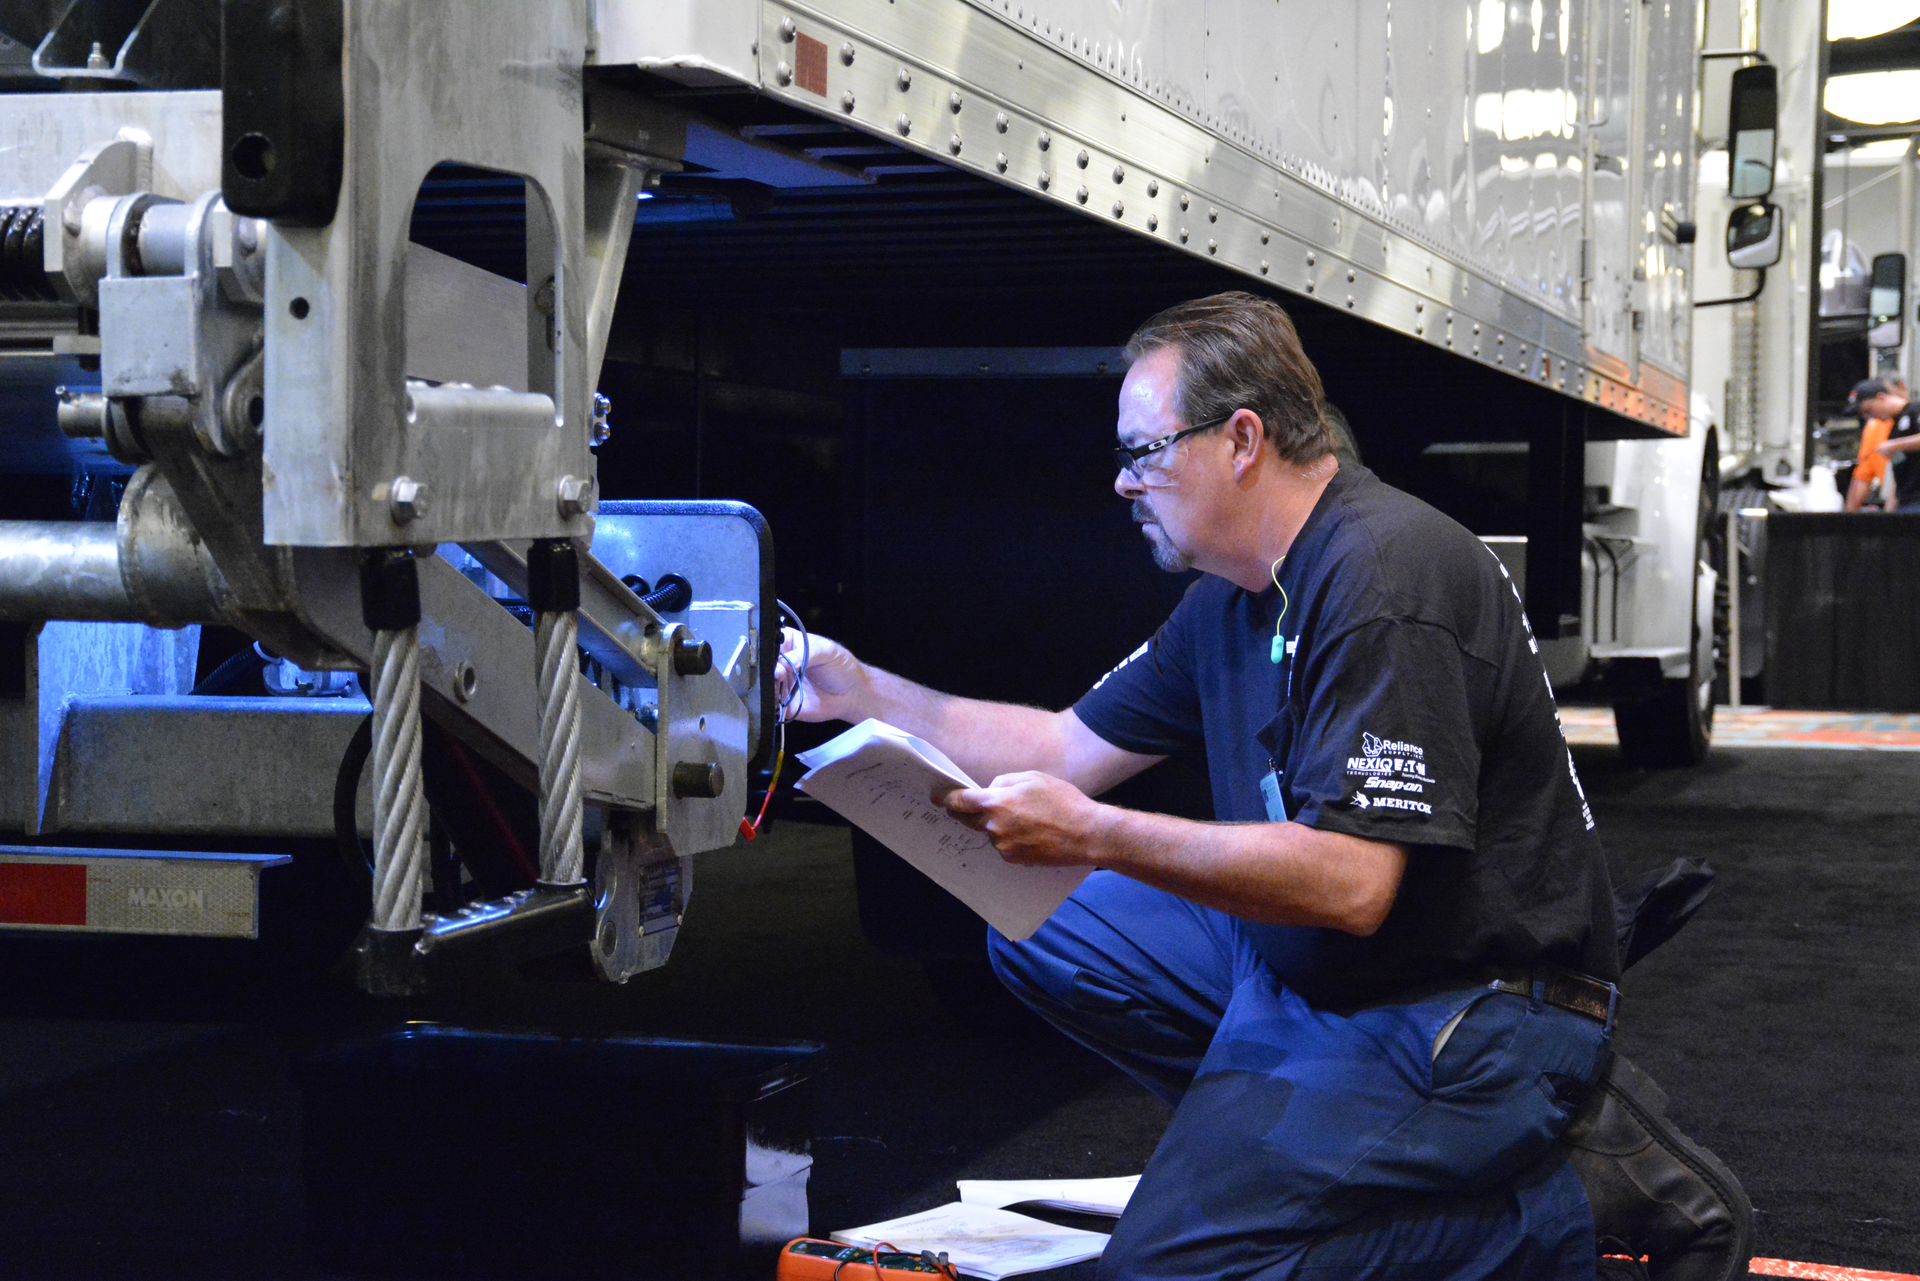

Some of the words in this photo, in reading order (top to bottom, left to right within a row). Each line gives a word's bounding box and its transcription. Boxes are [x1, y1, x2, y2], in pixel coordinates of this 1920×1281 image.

[1384, 740, 1424, 755] Reliance
[1347, 758, 1394, 772] NEXIQ
[1372, 797, 1432, 814] MERITOR
[127, 887, 204, 909] MAXON
